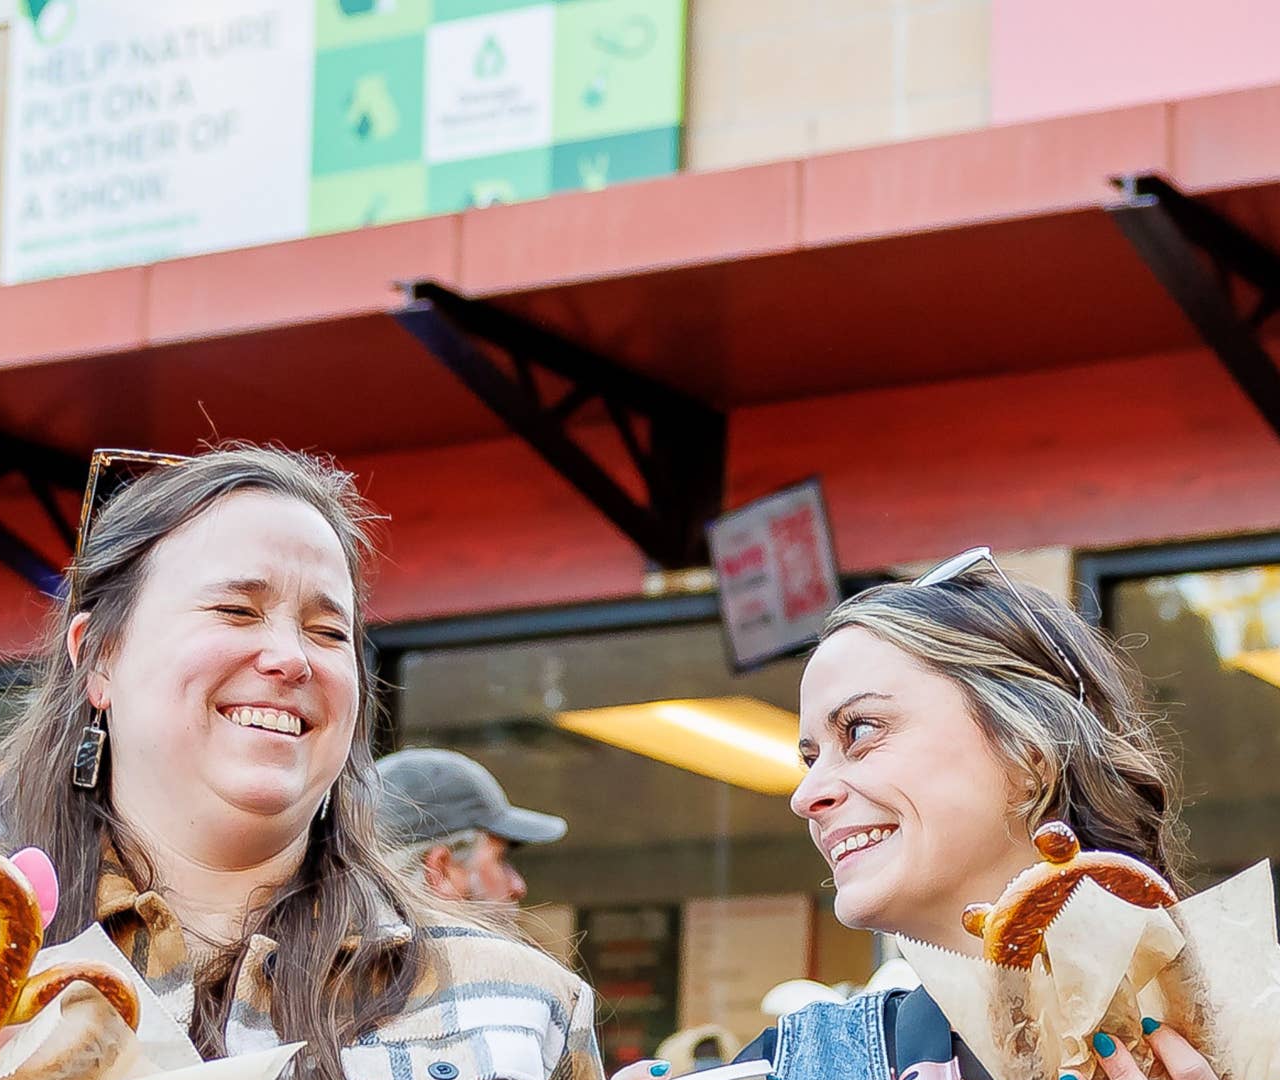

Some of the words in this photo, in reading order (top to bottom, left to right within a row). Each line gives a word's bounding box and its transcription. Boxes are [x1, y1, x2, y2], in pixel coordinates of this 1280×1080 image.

[25, 40, 120, 86] HELP
[22, 88, 93, 130] PUT
[101, 80, 161, 122] ON
[168, 75, 196, 107] A
[19, 119, 179, 176] MOTHER
[188, 107, 240, 152] OF
